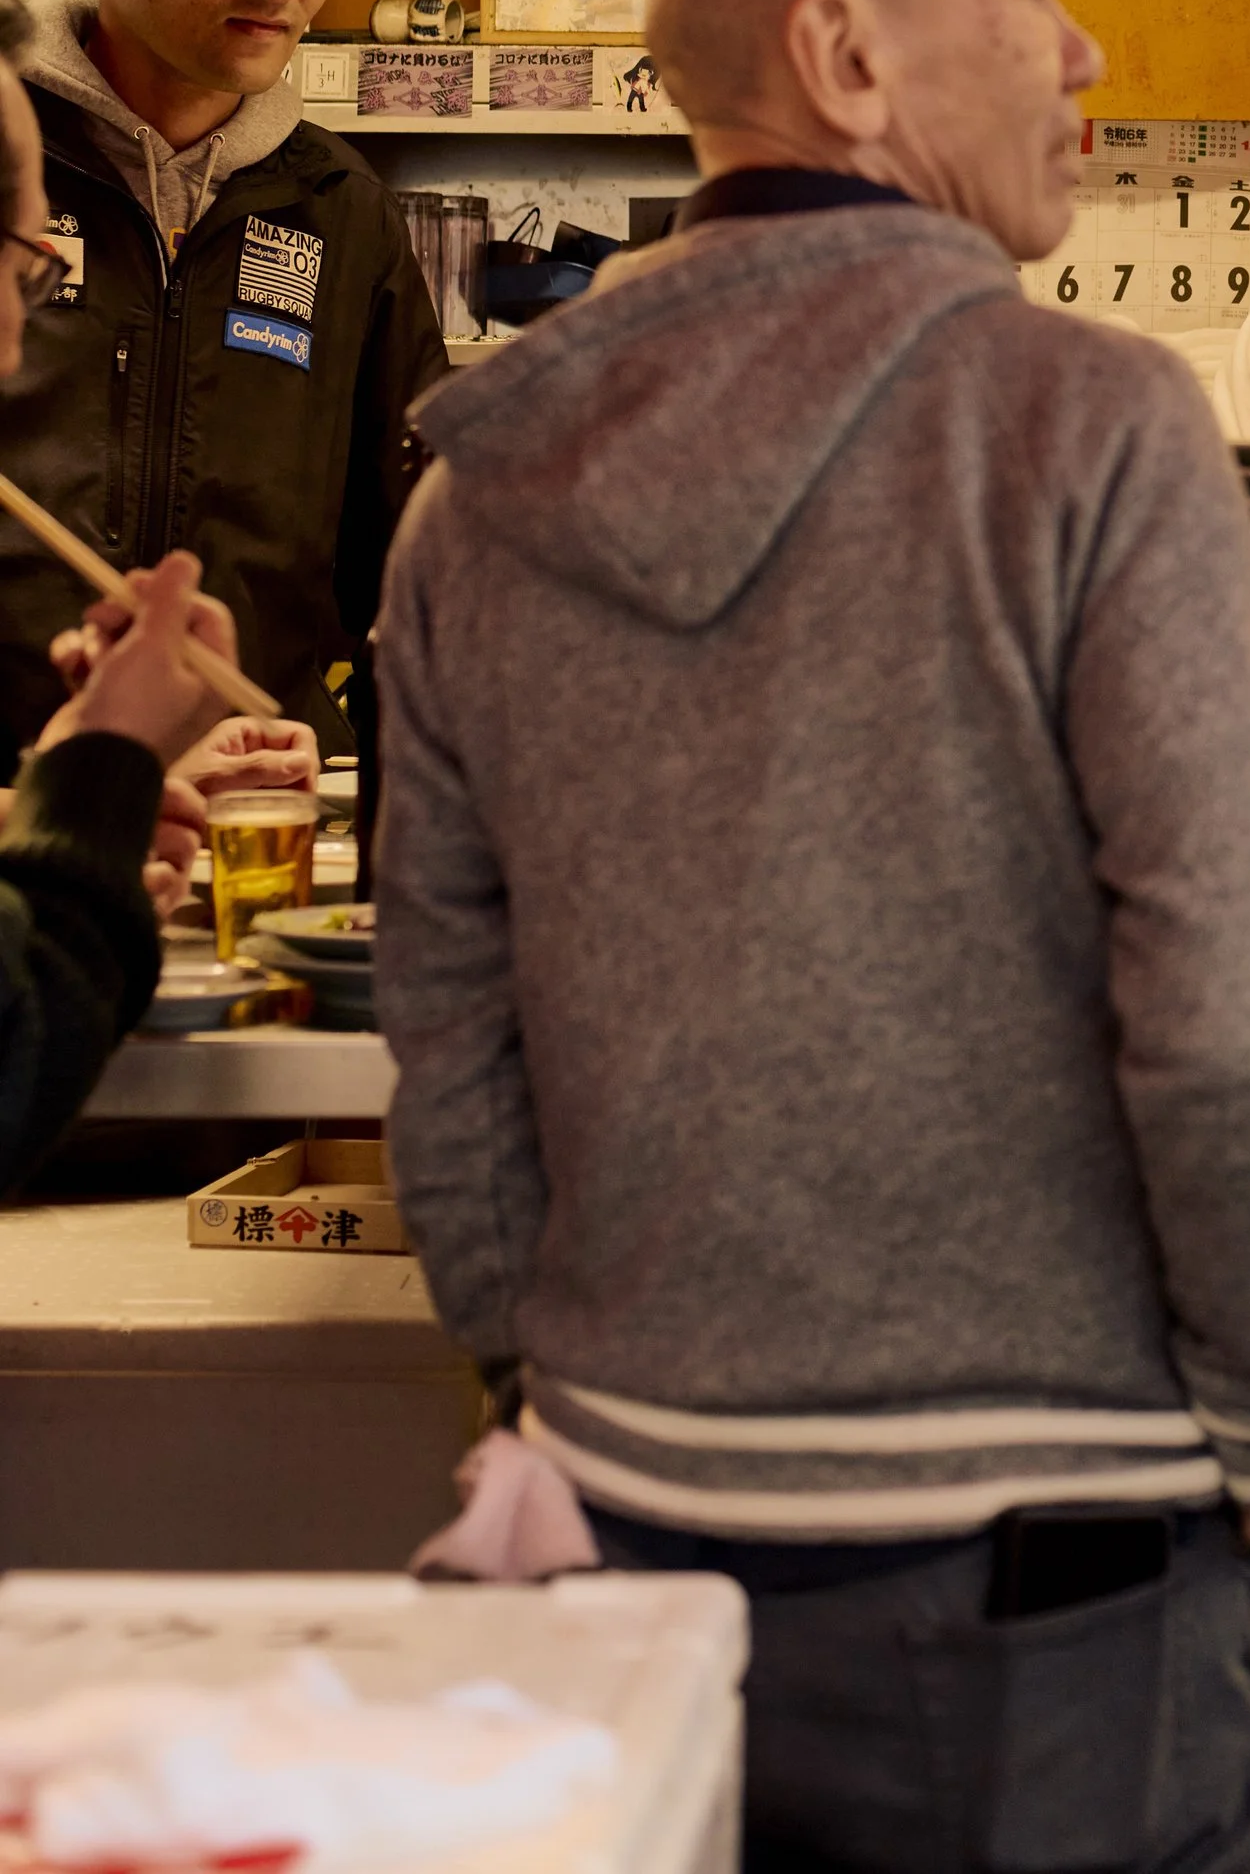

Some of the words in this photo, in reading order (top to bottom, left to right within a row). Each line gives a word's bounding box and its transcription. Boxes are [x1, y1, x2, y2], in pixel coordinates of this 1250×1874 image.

[1103, 126, 1148, 141] 令和6年
[1115, 172, 1138, 185] 木
[1171, 175, 1195, 189] 金
[1229, 179, 1250, 192] 土
[1176, 192, 1189, 228] 1
[1229, 195, 1250, 231] 2
[246, 217, 322, 258] AMAZING
[244, 243, 277, 260] Candyrim
[1057, 264, 1079, 303] 6
[1112, 264, 1135, 302] 7
[1171, 264, 1193, 303] 8
[1227, 266, 1250, 304] 9
[239, 287, 281, 308] RUGBY
[232, 321, 293, 351] Candyrim
